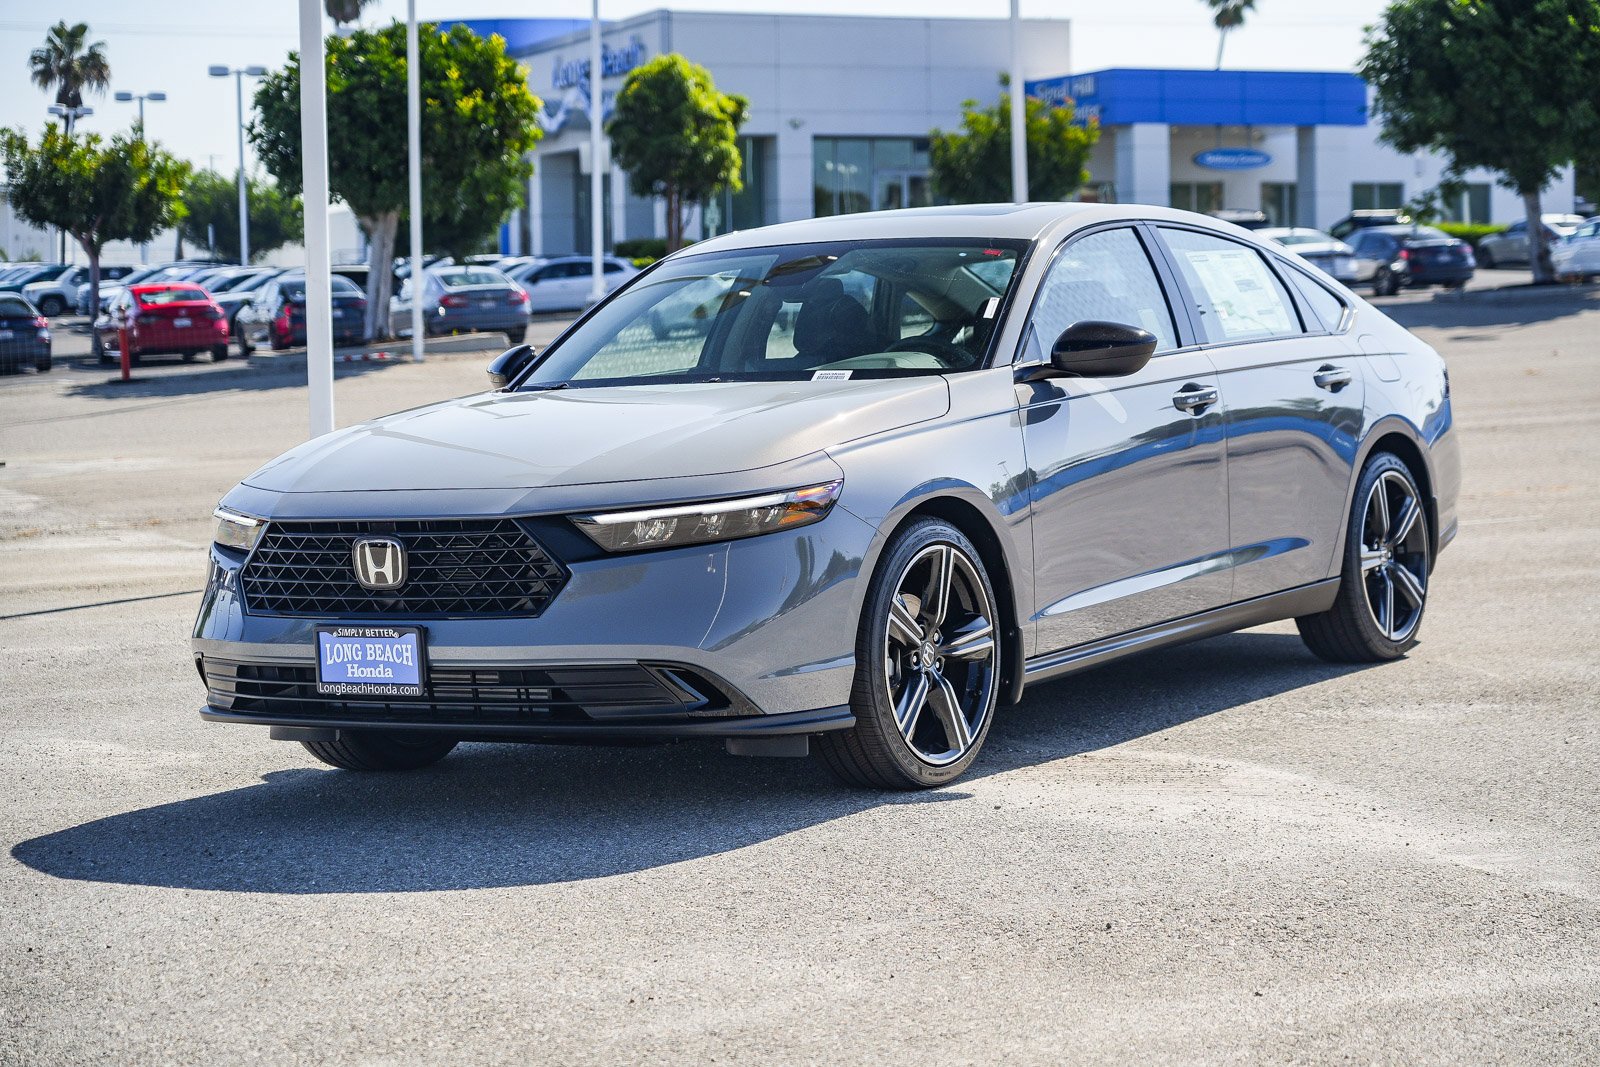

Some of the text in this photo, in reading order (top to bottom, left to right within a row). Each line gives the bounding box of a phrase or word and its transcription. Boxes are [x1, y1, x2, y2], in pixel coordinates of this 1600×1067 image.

[337, 628, 394, 637] SIMPLY BETTER
[325, 643, 413, 666] LONG BEACH
[346, 663, 394, 678] Honda
[319, 682, 419, 695] LongBeachHonda.com
